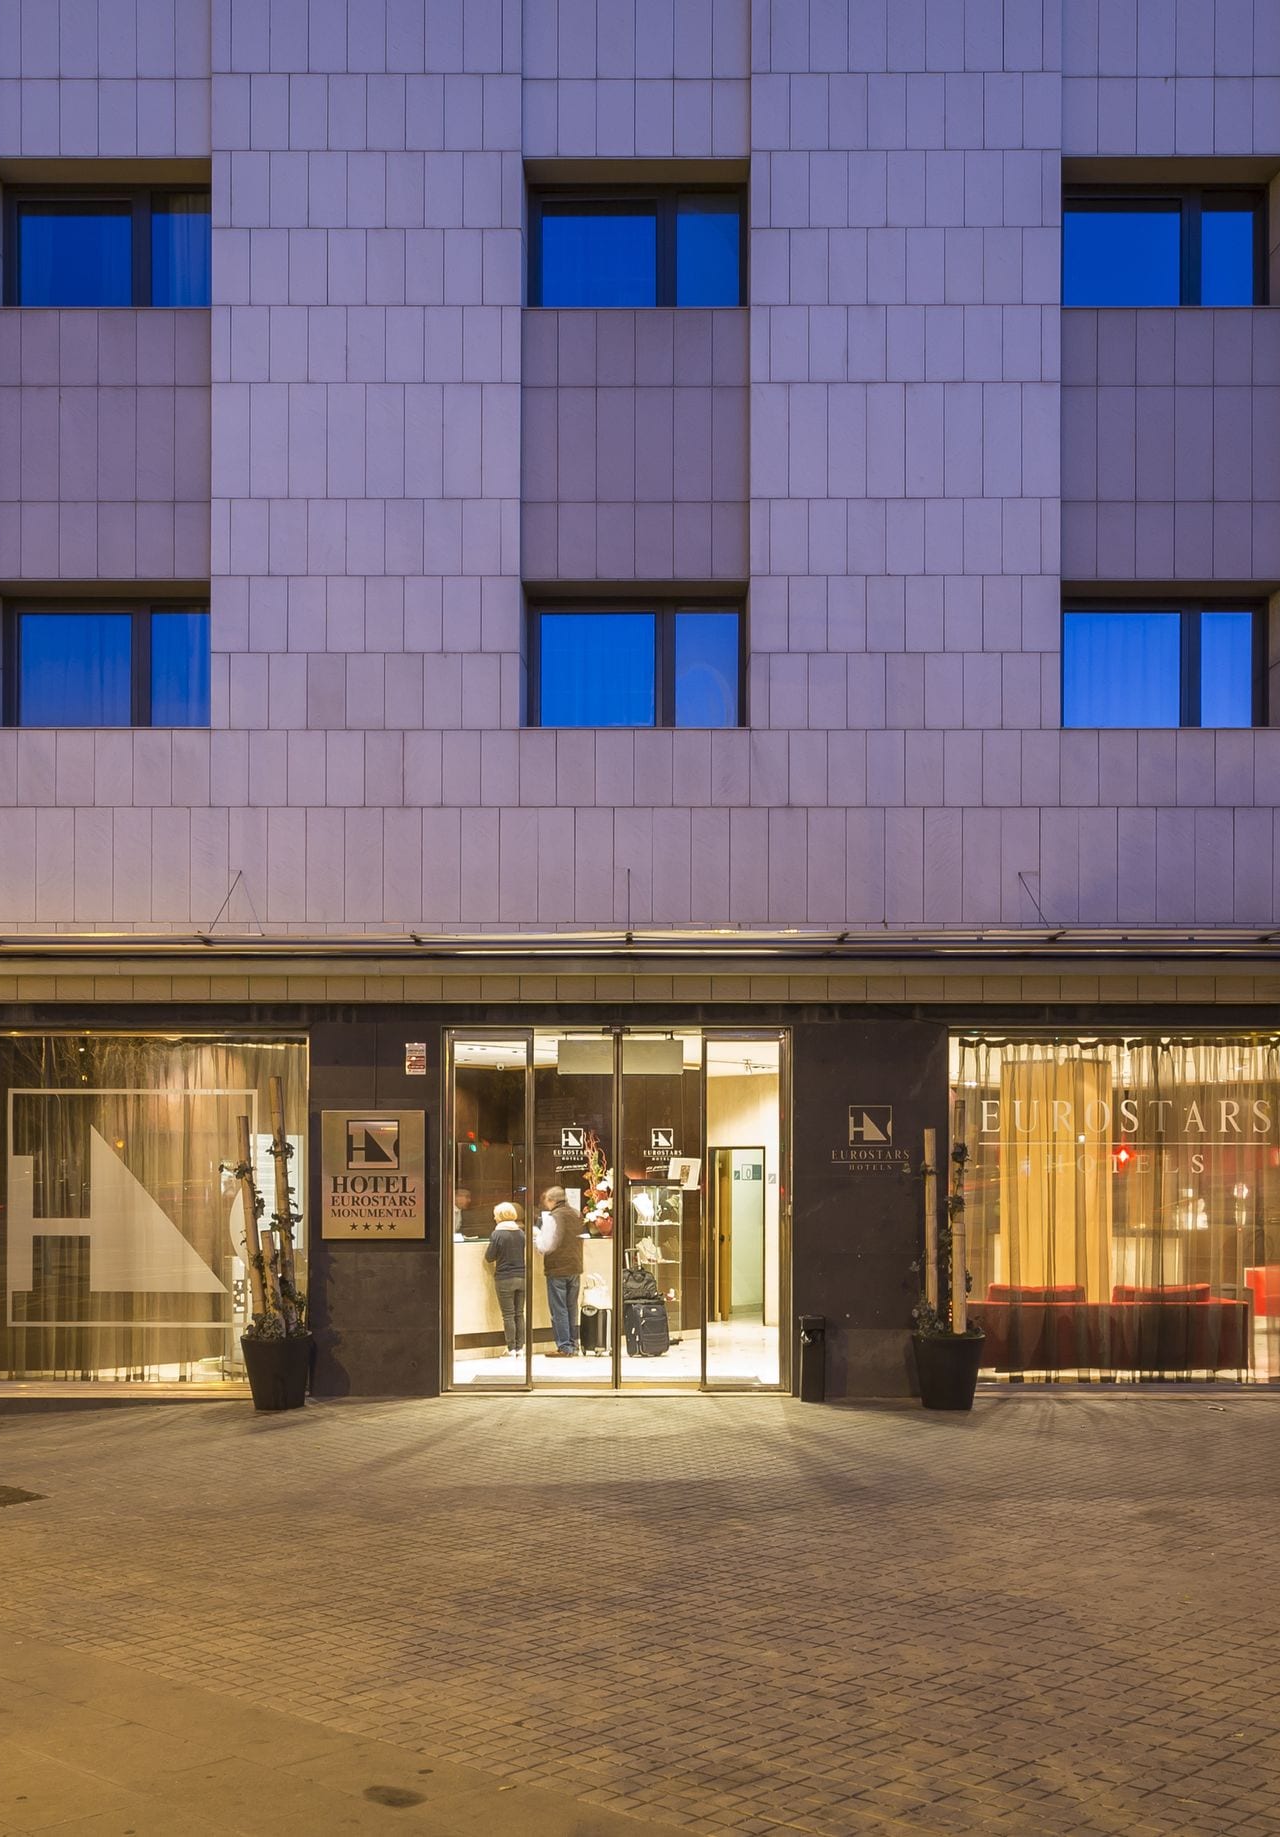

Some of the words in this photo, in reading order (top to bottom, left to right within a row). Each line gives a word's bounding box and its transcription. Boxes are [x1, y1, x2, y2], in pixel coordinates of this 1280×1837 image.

[980, 1099, 1272, 1134] EUROSTARS
[831, 1149, 910, 1160] EUROSTARS
[1046, 1154, 1205, 1174] HOTELS
[331, 1176, 416, 1194] HOTEL
[331, 1195, 417, 1207] EUROSTARS
[331, 1208, 417, 1218] MONUMENTAL
